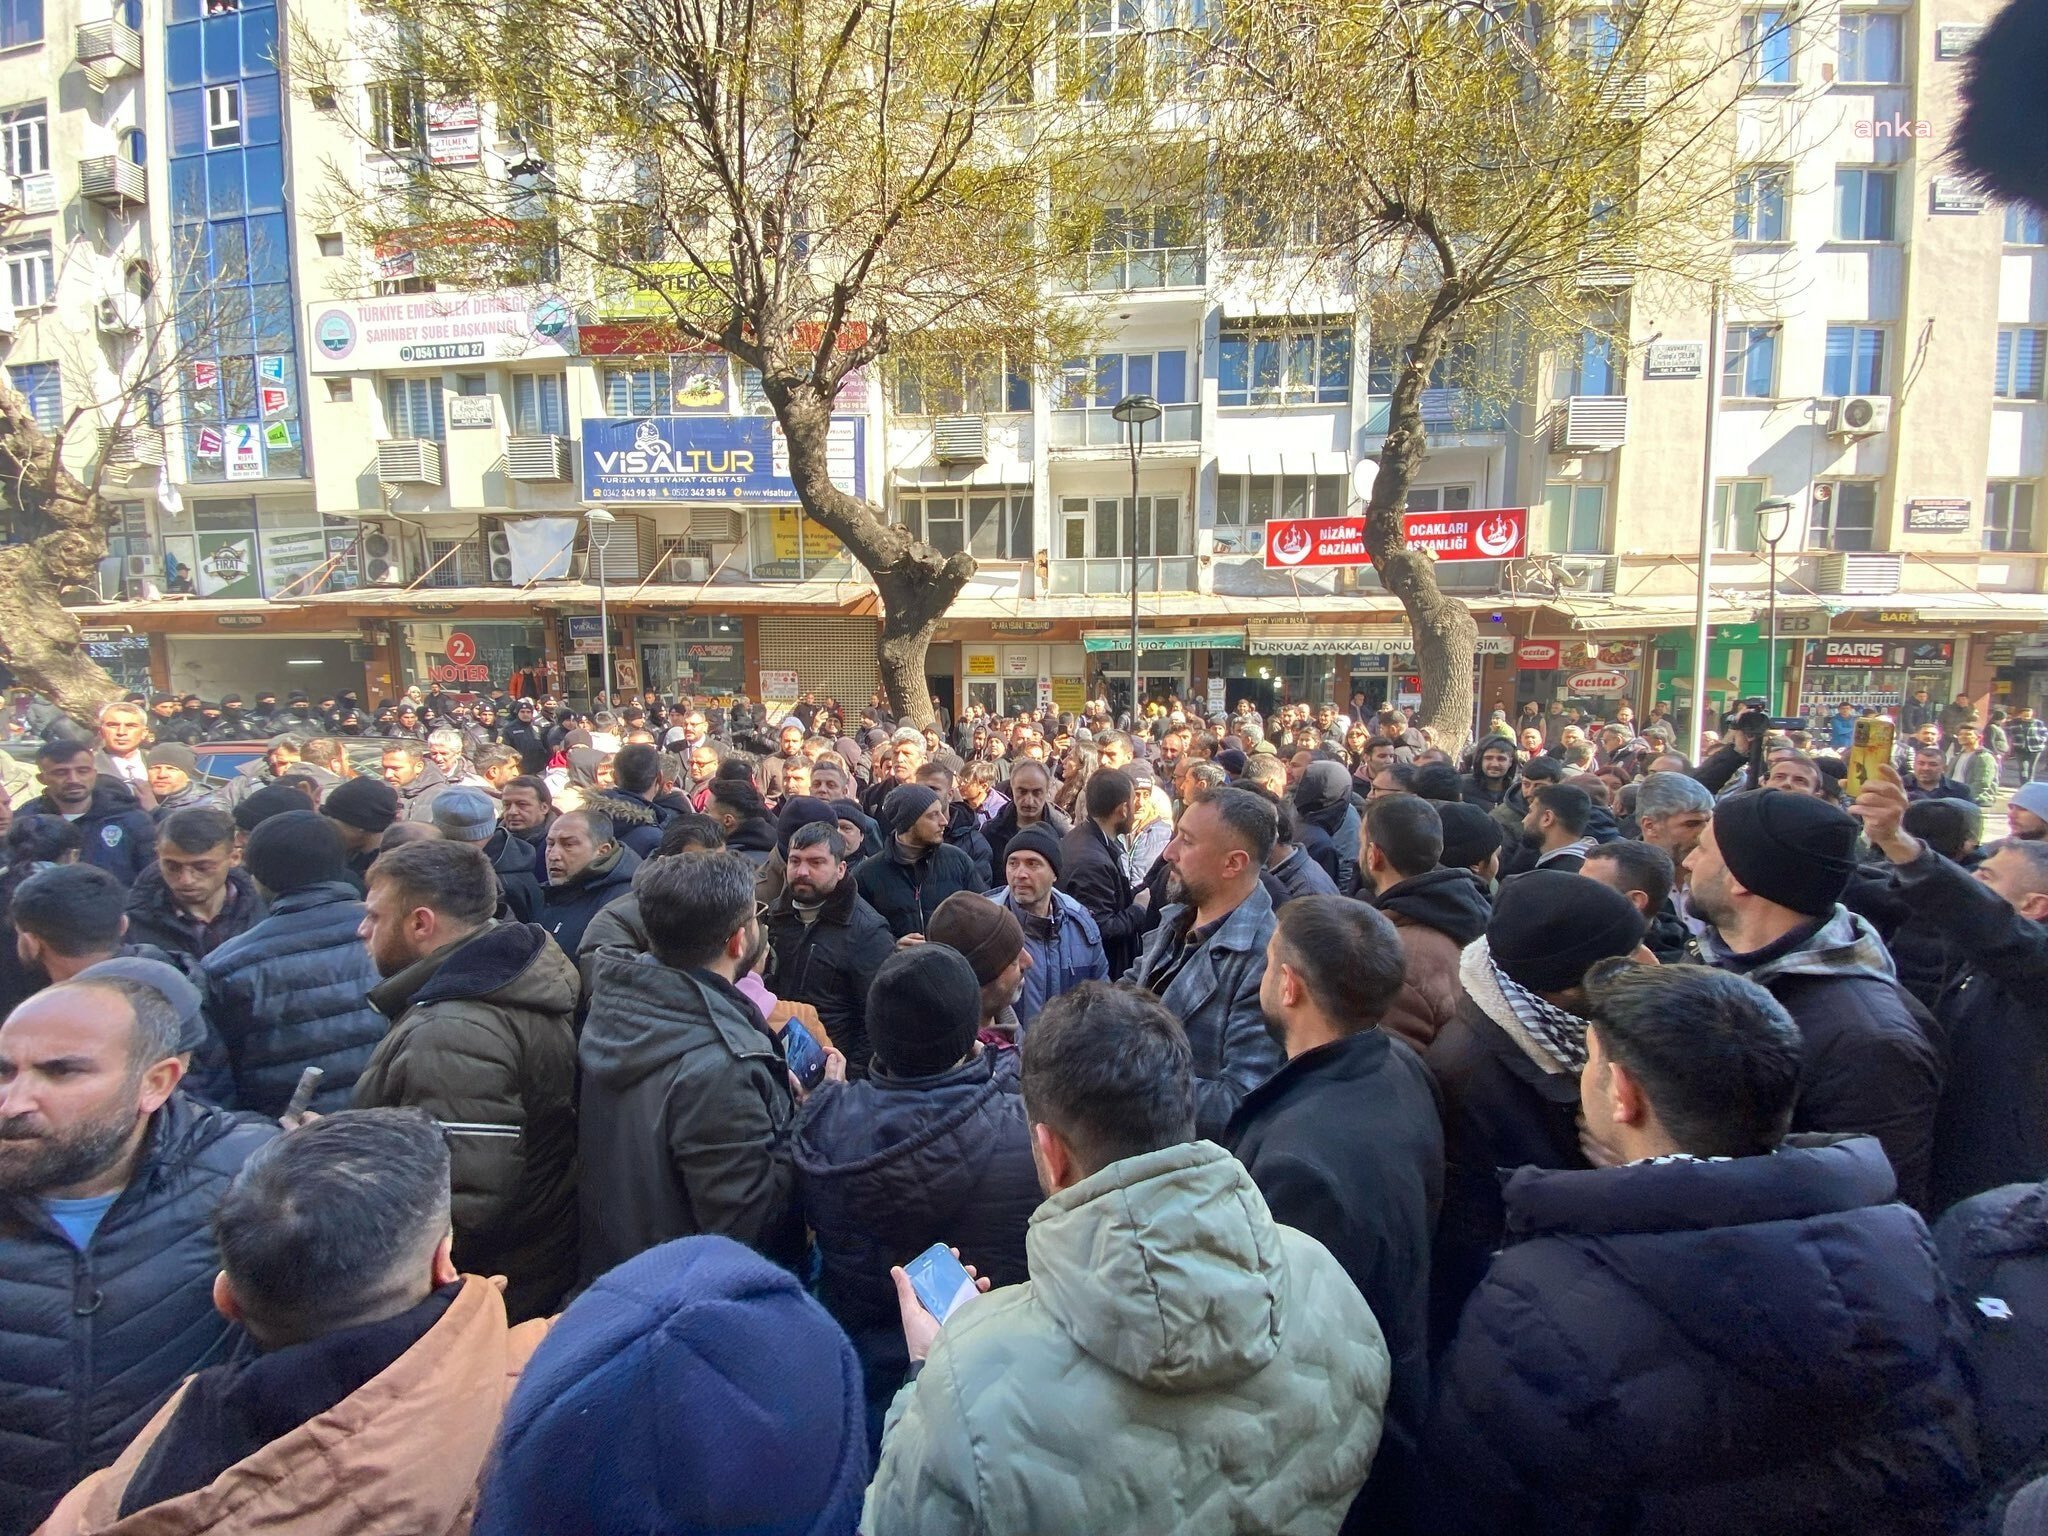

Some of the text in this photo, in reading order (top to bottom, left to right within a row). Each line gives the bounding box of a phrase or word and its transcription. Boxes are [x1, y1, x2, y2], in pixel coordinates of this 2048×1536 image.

[358, 303, 403, 322] TÜRKİYE
[366, 326, 418, 343] ŞAHİNBEY
[422, 324, 450, 341] ŞUBE
[415, 346, 437, 359] 0541
[439, 345, 456, 358] 917
[472, 343, 483, 355] 27
[639, 476, 650, 484] VE
[654, 476, 697, 484] SEYAHAT
[603, 489, 620, 497] 0342
[622, 489, 635, 497] 343
[636, 489, 646, 497] 98
[672, 488, 689, 497] 0532
[691, 488, 704, 497] 342
[716, 488, 726, 497] 56
[1320, 521, 1468, 541] NİZÂM- OCAKLARI
[1318, 535, 1467, 556] GAZİANT AŞKANLIĞI
[216, 560, 239, 570] FIRAT
[1766, 616, 1810, 631] EB
[453, 640, 470, 657] 2.
[1313, 642, 1373, 651] AYAKKABI
[1384, 642, 1412, 651] ONU
[1477, 640, 1499, 651] ŞİM
[1826, 643, 1884, 657] BARIŞ
[428, 664, 490, 682] NOTER
